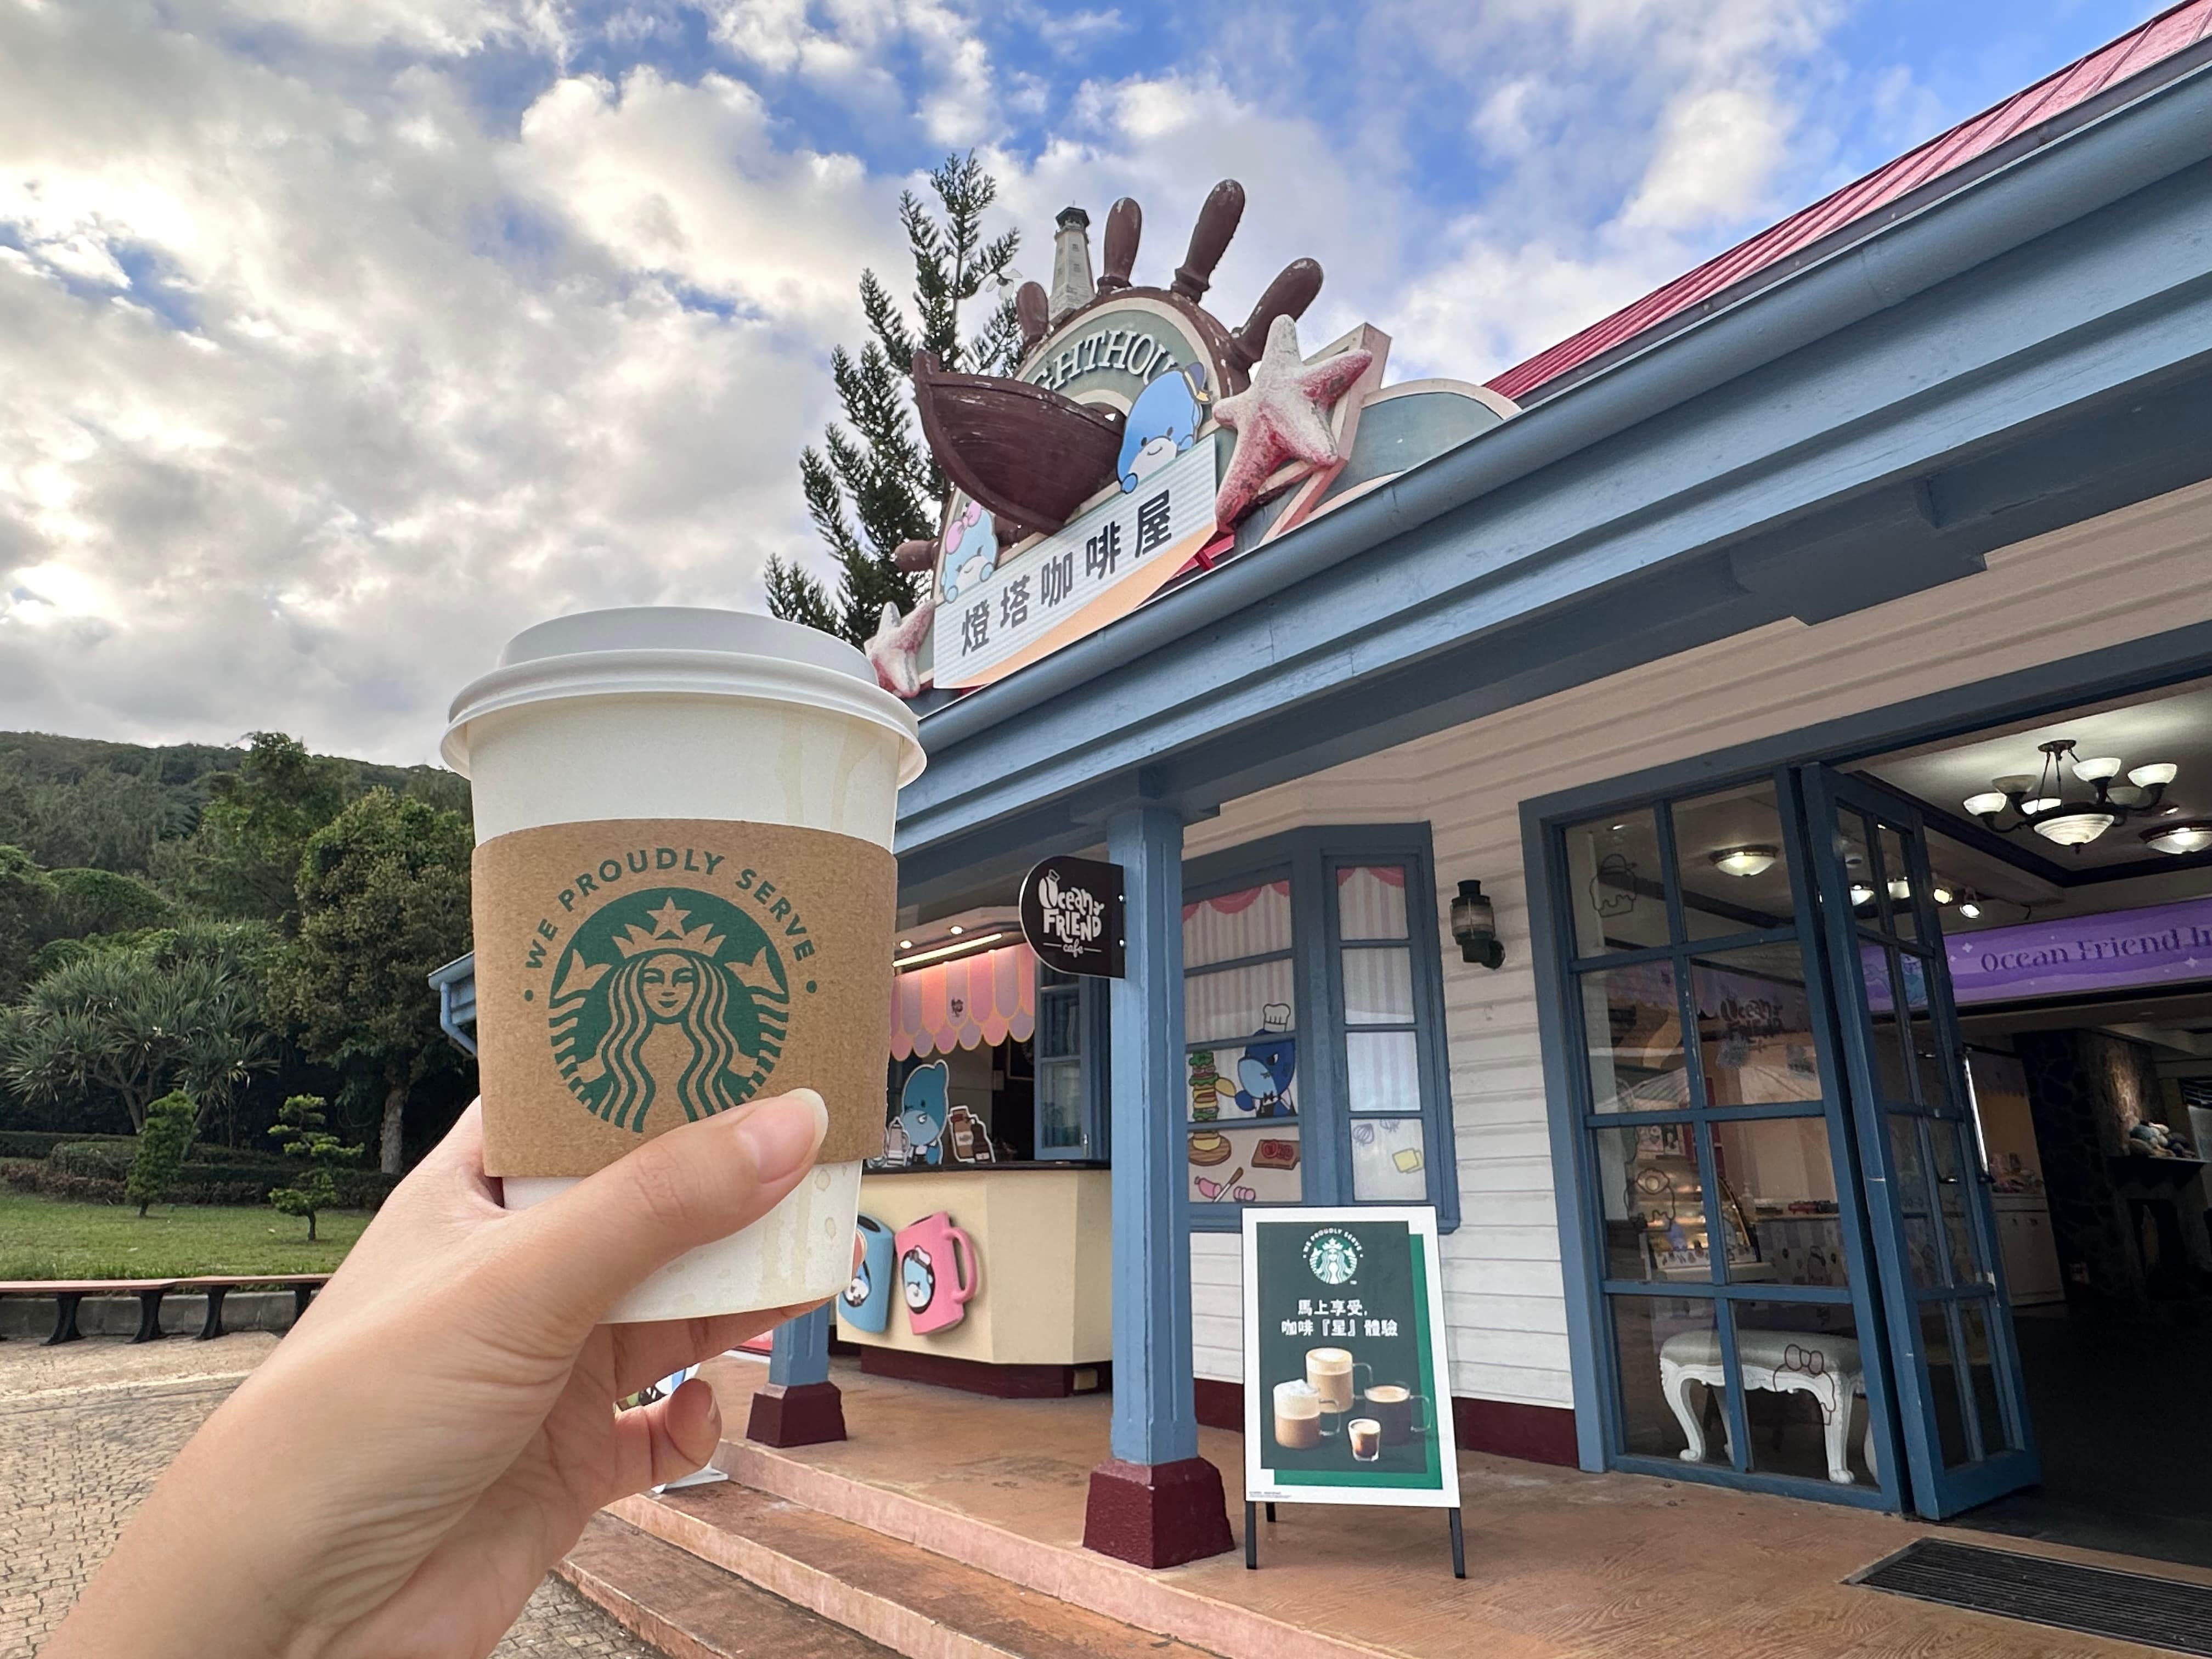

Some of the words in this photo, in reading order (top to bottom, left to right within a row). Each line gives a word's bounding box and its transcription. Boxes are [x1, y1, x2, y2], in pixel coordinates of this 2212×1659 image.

[962, 489, 1172, 657] 燈塔咖啡屋
[526, 918, 560, 970] WE
[557, 848, 725, 912] PROUDLY
[736, 868, 816, 961] SERVE
[1981, 948, 2069, 972] Ocean
[2076, 929, 2181, 961] Friend
